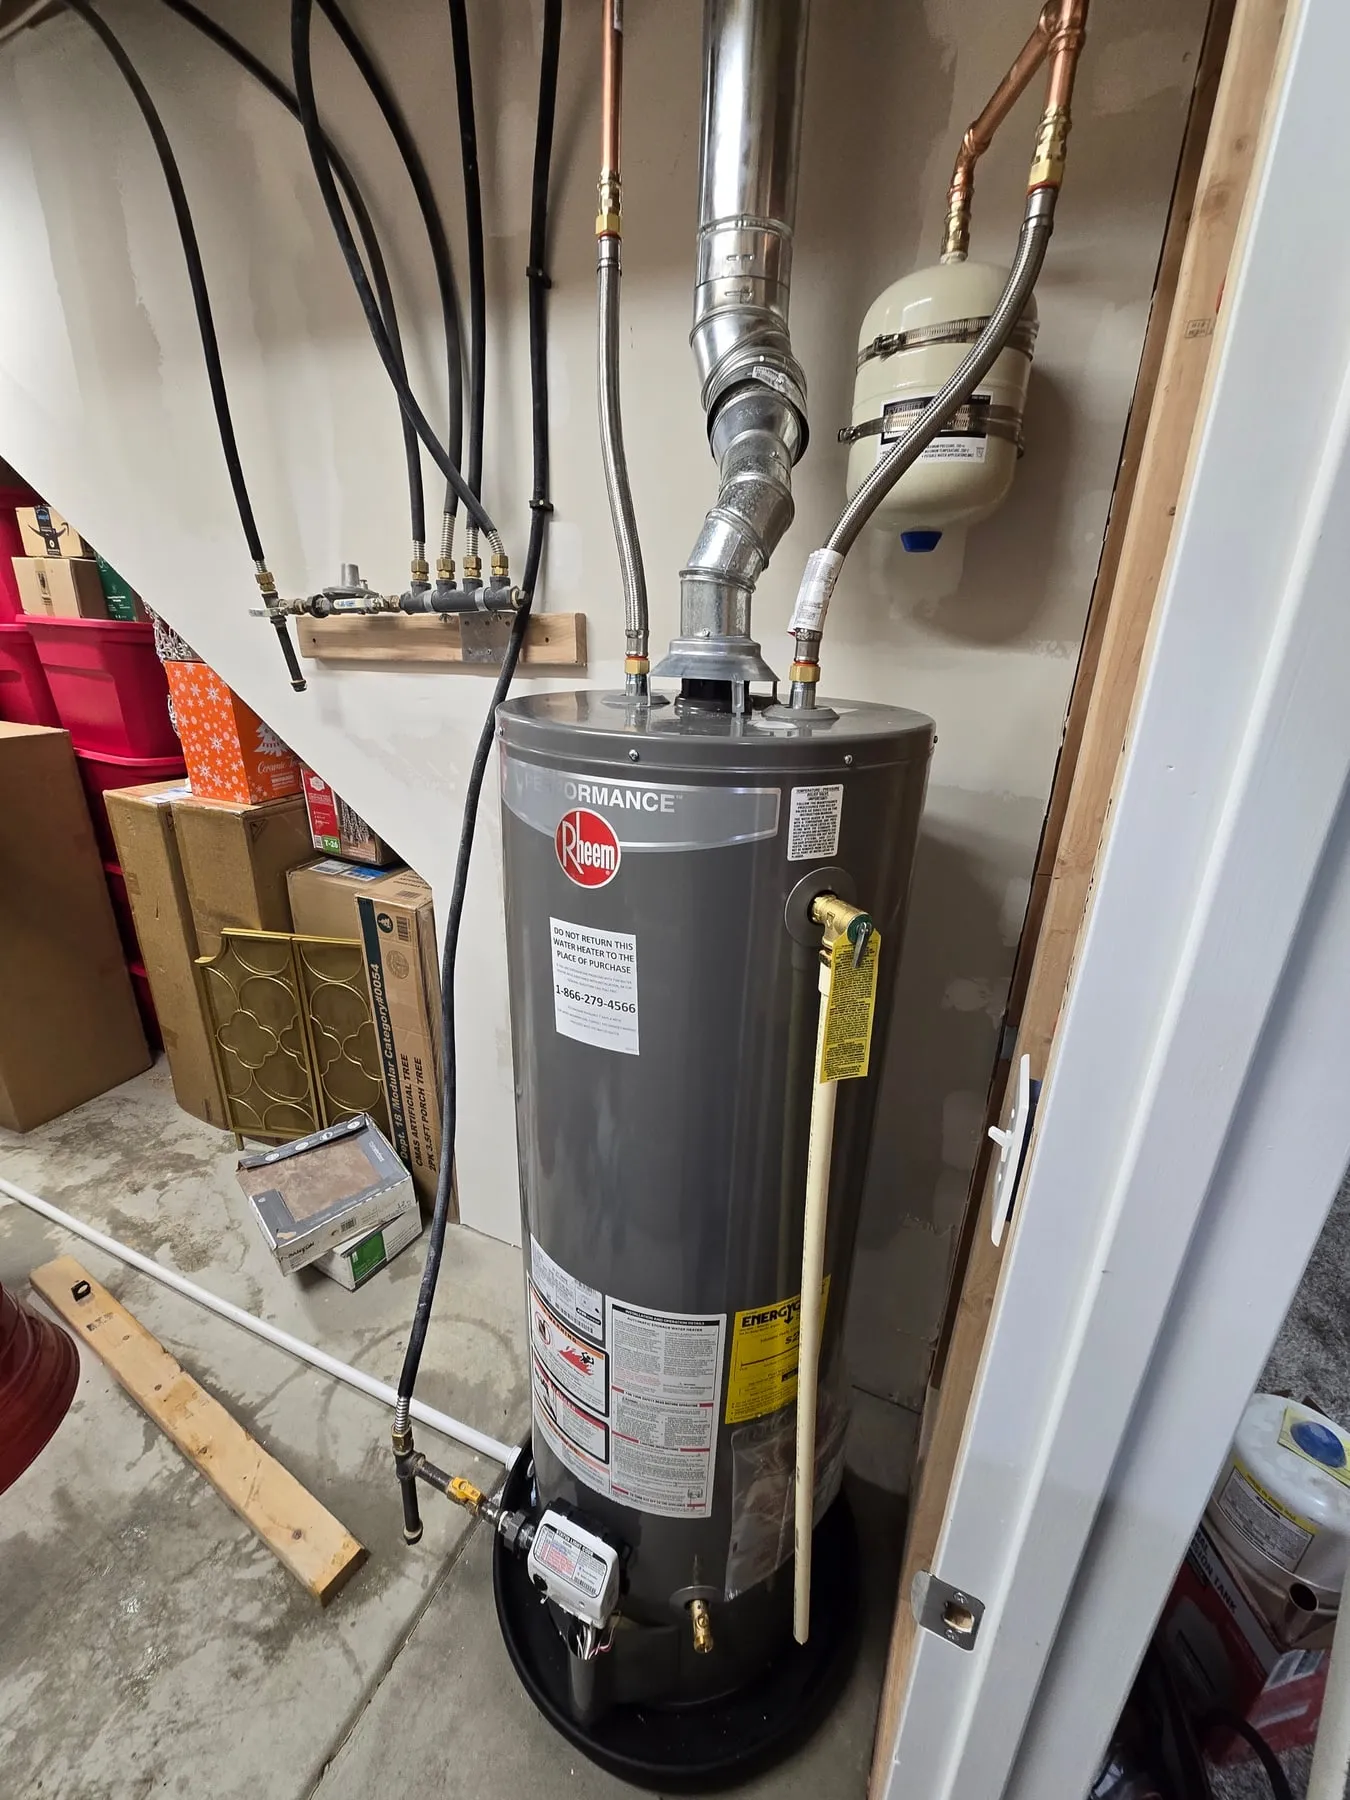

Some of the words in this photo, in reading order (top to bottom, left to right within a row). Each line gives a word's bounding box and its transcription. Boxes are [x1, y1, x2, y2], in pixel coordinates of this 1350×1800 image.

[562, 811, 614, 874] Rheem
[553, 937, 576, 951] WATER
[577, 945, 604, 957] HEATER
[606, 951, 617, 960] TO
[619, 954, 634, 962] THE
[554, 927, 564, 936] DO
[565, 931, 580, 940] NOT
[582, 935, 612, 947] RETURN
[614, 941, 633, 950] THIS
[557, 950, 576, 962] PLACE
[578, 957, 588, 965] OF
[590, 960, 631, 974] PURCHASE
[370, 963, 394, 1059] Category#0054
[556, 984, 636, 1014] 1-866-279-4566
[400, 1053, 412, 1081] TREE
[414, 1056, 424, 1085] TREE
[404, 1083, 420, 1139] ARTIFICIAL
[418, 1087, 430, 1124] PORCH
[412, 1140, 424, 1166] CMAS
[428, 1154, 437, 1172] 2PK
[1214, 1575, 1237, 1614] TANK
